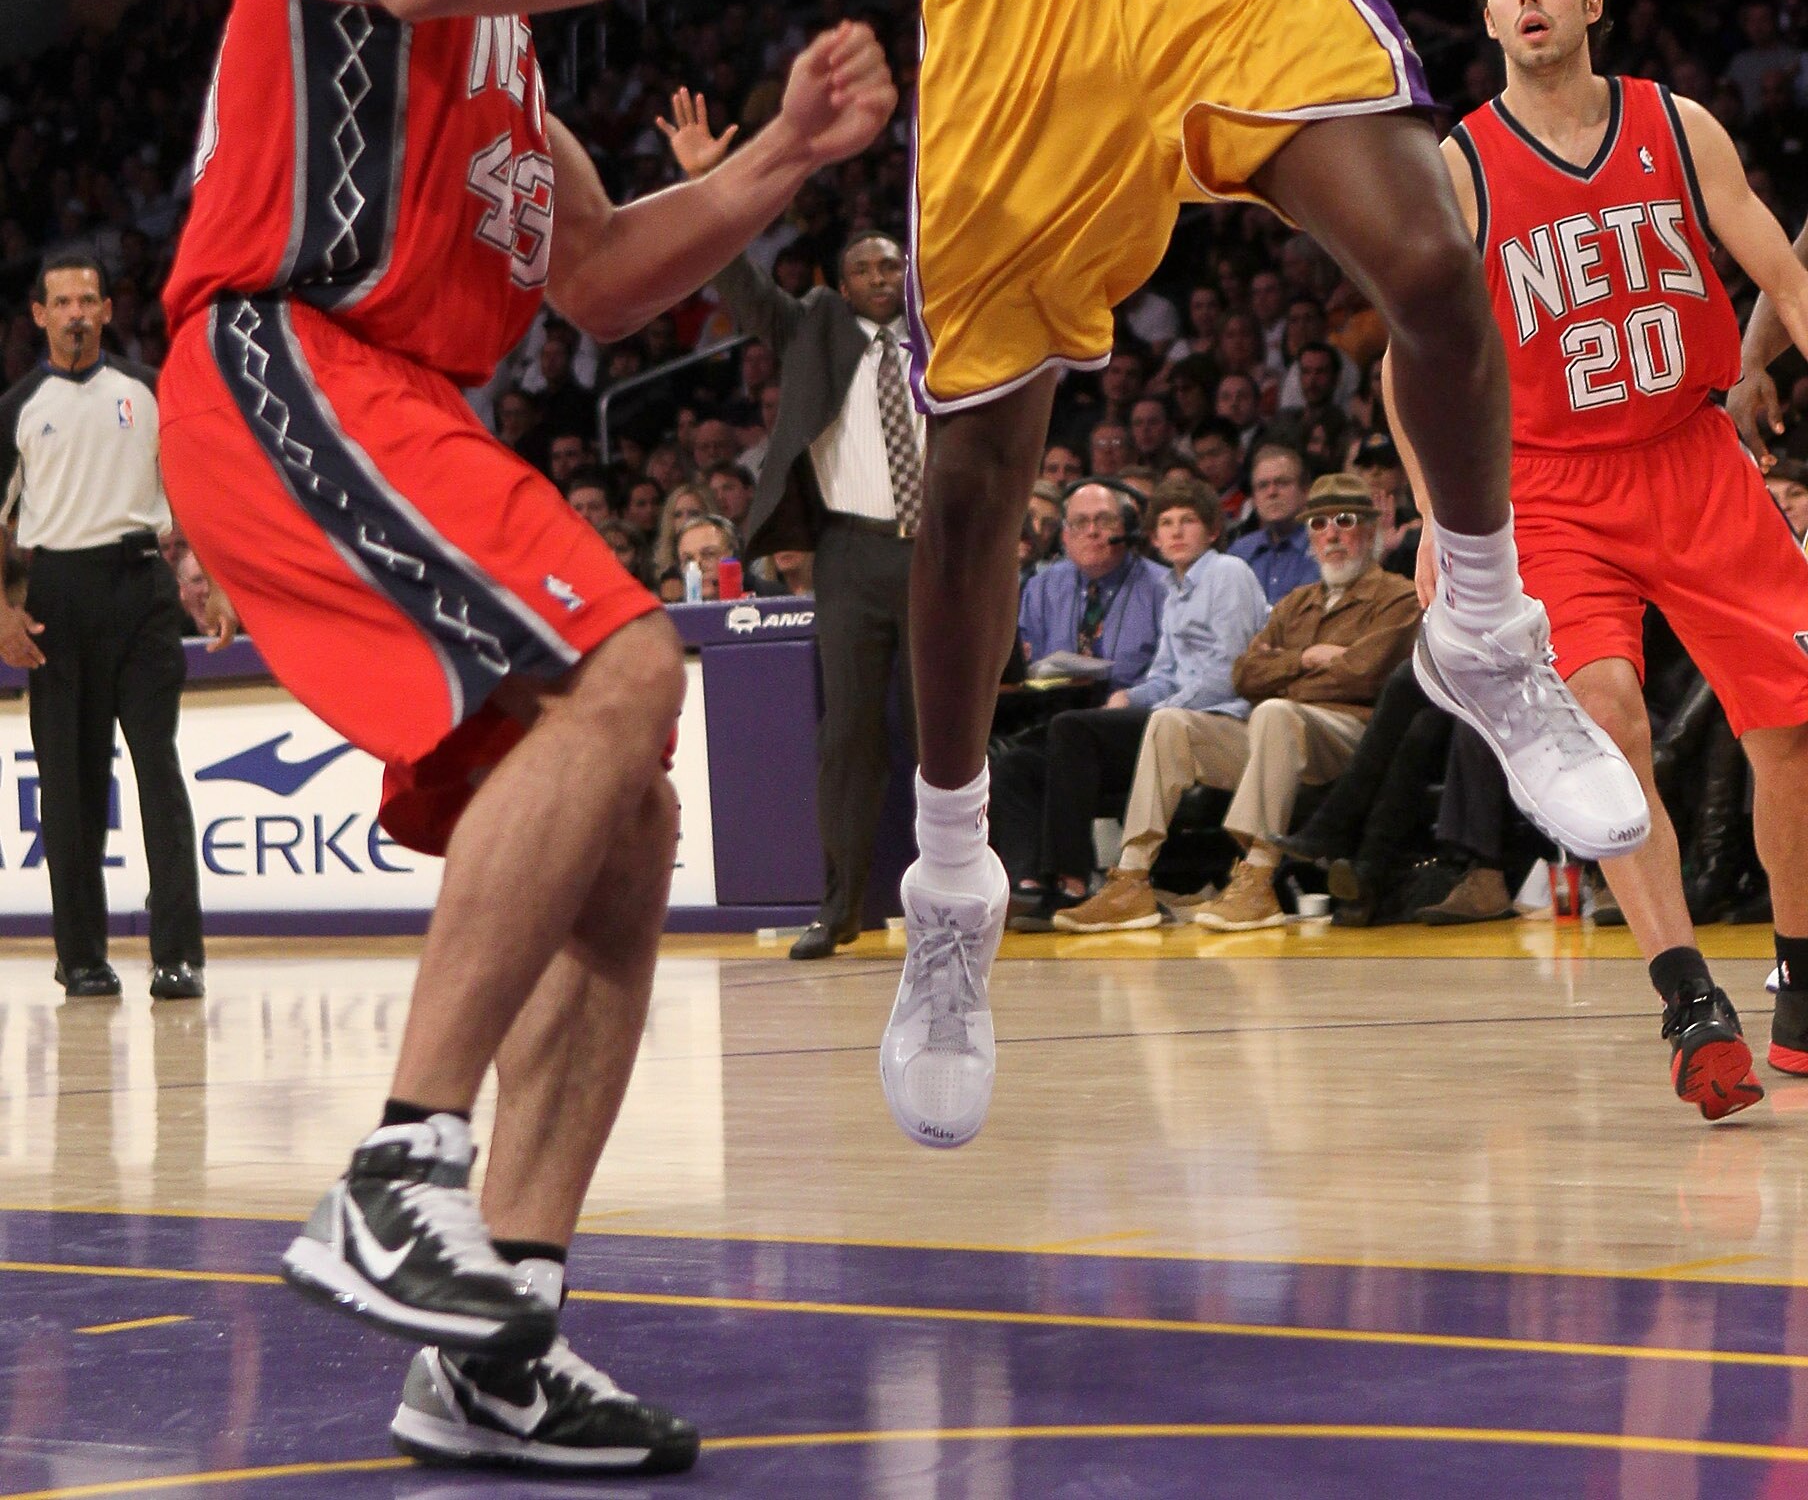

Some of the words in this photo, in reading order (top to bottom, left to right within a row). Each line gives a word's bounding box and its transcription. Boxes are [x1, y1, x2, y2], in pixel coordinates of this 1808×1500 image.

[465, 132, 555, 289] 43
[1500, 199, 1708, 347] NETS
[1559, 302, 1687, 413] 20
[761, 611, 816, 630] ANC
[202, 812, 416, 876] ERKE
